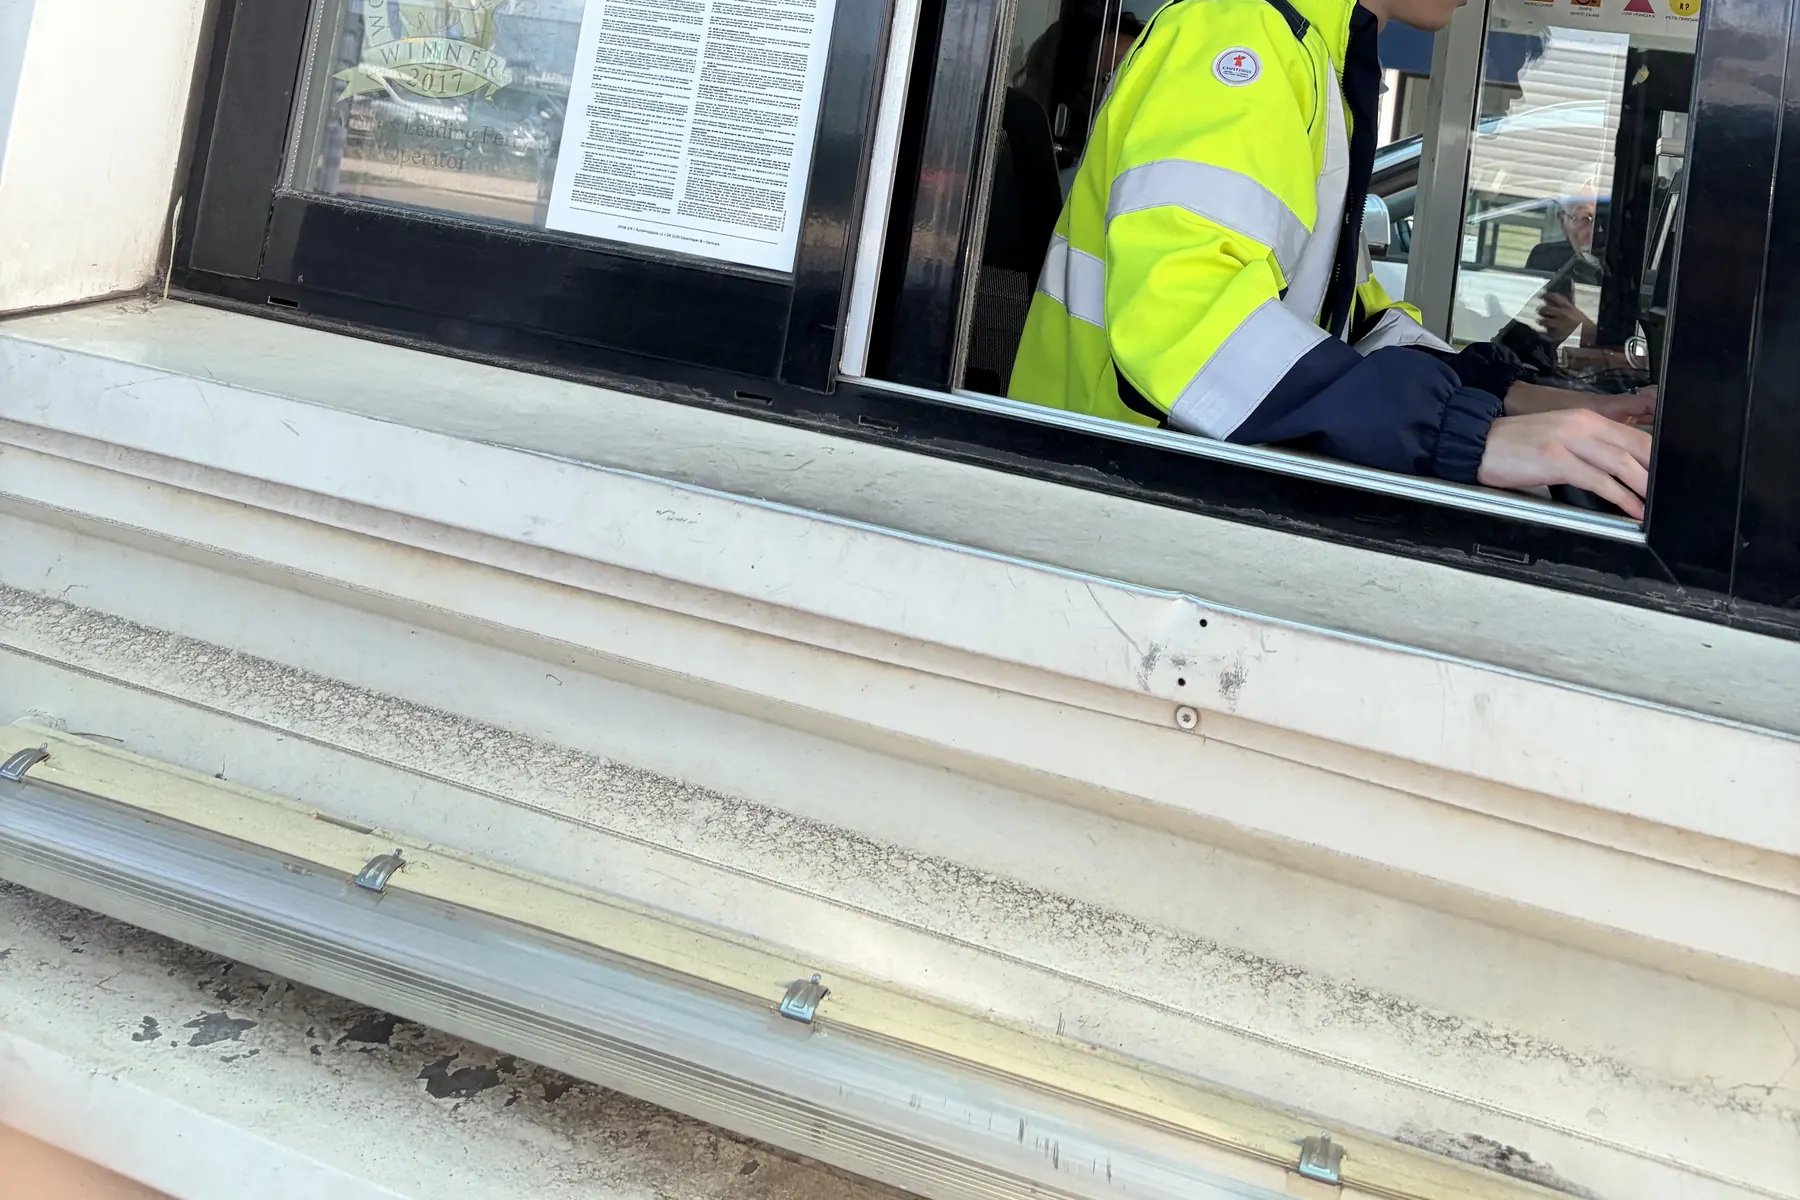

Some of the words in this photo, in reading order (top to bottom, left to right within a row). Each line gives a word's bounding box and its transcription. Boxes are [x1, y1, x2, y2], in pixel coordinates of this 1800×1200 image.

[380, 41, 502, 79] WINNER
[405, 68, 465, 94] 2017
[383, 148, 467, 170] Operator
